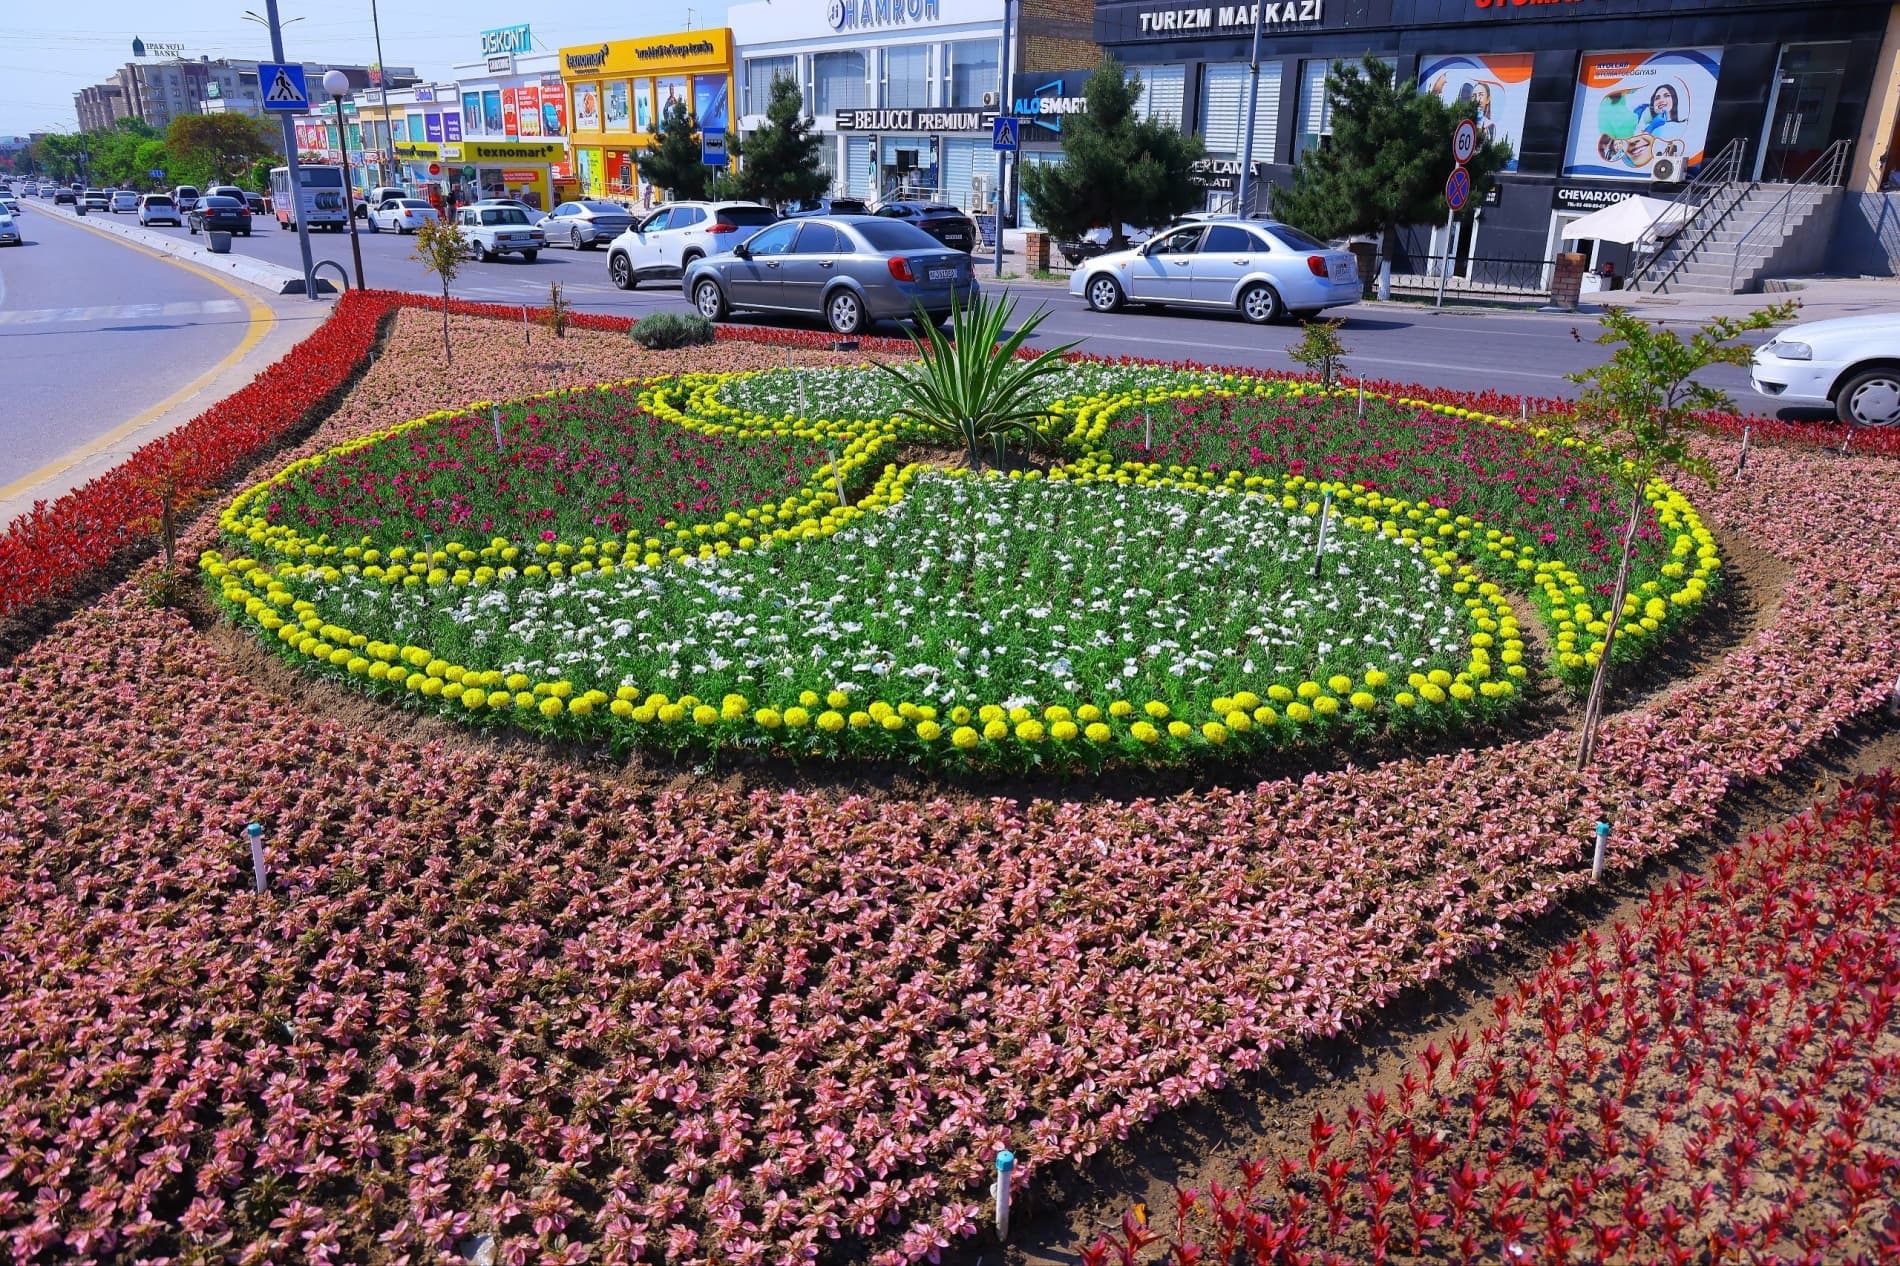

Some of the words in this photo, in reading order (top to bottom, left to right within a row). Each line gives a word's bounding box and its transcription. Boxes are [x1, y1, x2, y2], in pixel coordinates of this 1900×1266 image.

[845, 0, 941, 27] HAMROH
[1140, 8, 1212, 31] TURIZM
[481, 28, 527, 54] DISKONT
[1013, 97, 1089, 115] ALOSMART
[855, 110, 914, 130] BELUCCI
[918, 113, 980, 130] PREMIUM
[1458, 133, 1471, 150] 60
[477, 146, 547, 158] texnomart
[1558, 189, 1633, 203] CHEVARXON
